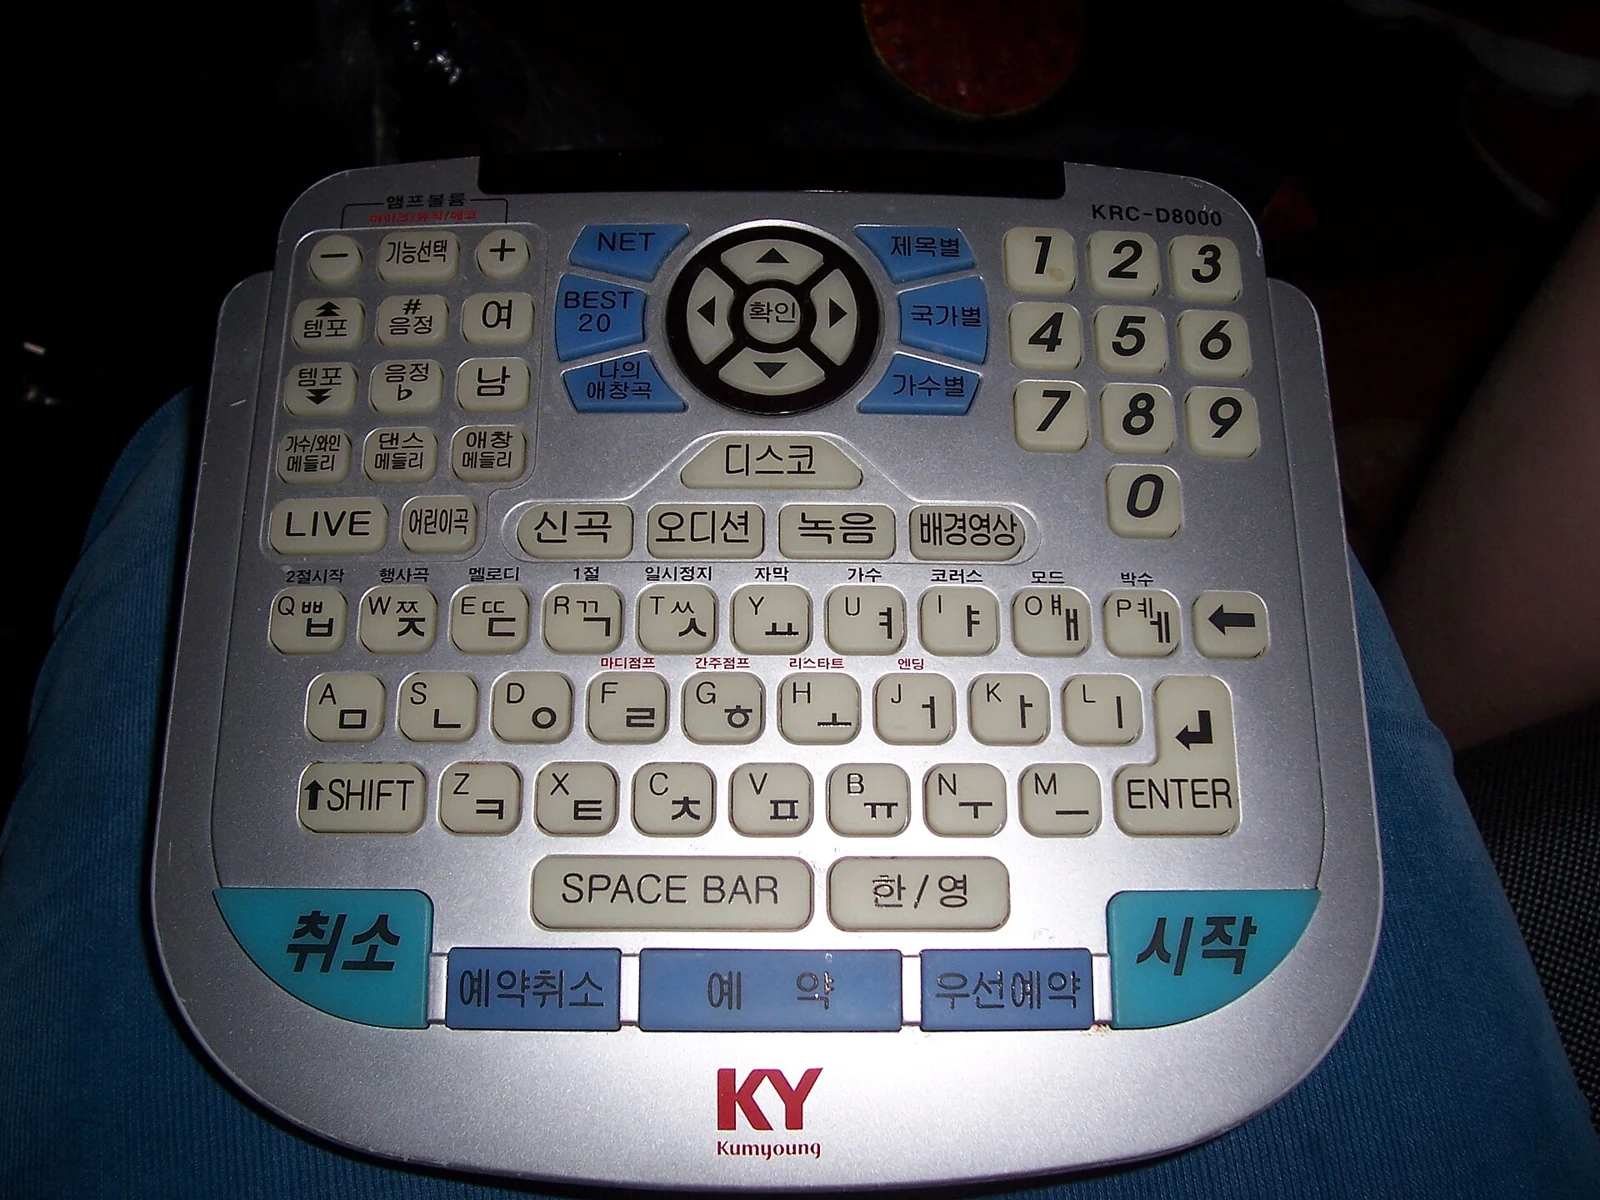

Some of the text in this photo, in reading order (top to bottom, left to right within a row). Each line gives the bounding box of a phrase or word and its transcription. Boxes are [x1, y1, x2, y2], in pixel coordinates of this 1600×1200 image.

[385, 192, 466, 210] 앰프볼륨
[1090, 203, 1223, 227] KRC-D8000
[385, 239, 448, 265] 기능선택
[596, 231, 656, 252] NET
[890, 235, 961, 258] 제목별
[1033, 235, 1053, 275] 1
[1107, 239, 1144, 280] 2
[1191, 243, 1222, 284] 3
[563, 290, 635, 310] BEST
[481, 298, 513, 330] 여
[577, 313, 612, 333] 20
[748, 301, 796, 324] 확인
[910, 304, 982, 328] 국가별
[303, 319, 348, 339] 템포
[388, 314, 434, 336] 음정
[1027, 311, 1065, 353] 4
[1111, 315, 1147, 357] 5
[1199, 319, 1232, 361] 6
[297, 367, 343, 387] 템포
[384, 362, 430, 384] 음정
[476, 364, 511, 397] 남
[599, 360, 641, 381] 나의
[586, 381, 653, 401] 애창곡
[891, 373, 966, 398] 가수별
[1035, 389, 1072, 432] 7
[1121, 391, 1156, 436] 8
[1209, 396, 1243, 439] 9
[285, 433, 341, 454] 가수/와인
[378, 431, 424, 450] 댄스
[465, 430, 514, 449] 애창
[286, 454, 336, 473] 메들리
[373, 452, 424, 471] 메들리
[461, 450, 513, 470] 메들리
[724, 443, 816, 477] 디스코
[1125, 473, 1165, 519] 0
[284, 509, 372, 538] LIVE
[408, 507, 470, 536] 어린이곡
[533, 510, 613, 544] 신곡
[655, 509, 750, 545] 오디션
[797, 511, 877, 545] 녹음
[919, 511, 1018, 547] 배경영상
[285, 568, 346, 585] 2절시작
[378, 566, 430, 584] 행사곡
[468, 566, 521, 583] 멜로디
[572, 566, 601, 582] 1절
[644, 565, 713, 582] 일시정지
[754, 565, 790, 582] 자막
[846, 566, 883, 583] 가수
[930, 568, 984, 584] 코러스
[1030, 570, 1066, 585] 모드
[1120, 571, 1155, 588] 박수
[277, 595, 296, 617] Q
[367, 595, 392, 616] W
[461, 596, 477, 615] E
[553, 595, 571, 616] R
[649, 595, 666, 615] T
[748, 595, 765, 616] Y
[844, 595, 861, 617] U
[937, 594, 943, 614] I
[1024, 595, 1043, 616] O
[1116, 598, 1132, 618] P
[599, 656, 656, 670] 마디점프
[694, 656, 751, 670] 간주점프
[788, 656, 846, 670] 리스타트
[896, 657, 925, 671] 엔딩
[318, 682, 338, 706] A
[409, 681, 428, 706] S
[506, 682, 526, 705] D
[600, 681, 619, 705] F
[695, 681, 717, 705] G
[791, 681, 812, 705] H
[890, 683, 902, 705] J
[985, 682, 1003, 703] K
[1081, 683, 1096, 704] L
[326, 777, 415, 812] SHIFT
[452, 772, 470, 795] Z
[549, 772, 570, 797] X
[649, 771, 669, 796] C
[748, 771, 769, 796] V
[846, 772, 865, 796] B
[937, 772, 957, 797] N
[1033, 771, 1058, 796] M
[1126, 776, 1233, 810] ENTER
[560, 871, 779, 905] SPACE BAR
[871, 873, 968, 909] 한/영
[284, 910, 401, 971] 취소
[1135, 915, 1258, 975] 시작
[458, 968, 605, 1010] 예약취소
[934, 970, 1081, 1011] 우선예약
[716, 1066, 823, 1132] KY
[716, 1139, 821, 1162] Kumyoung
